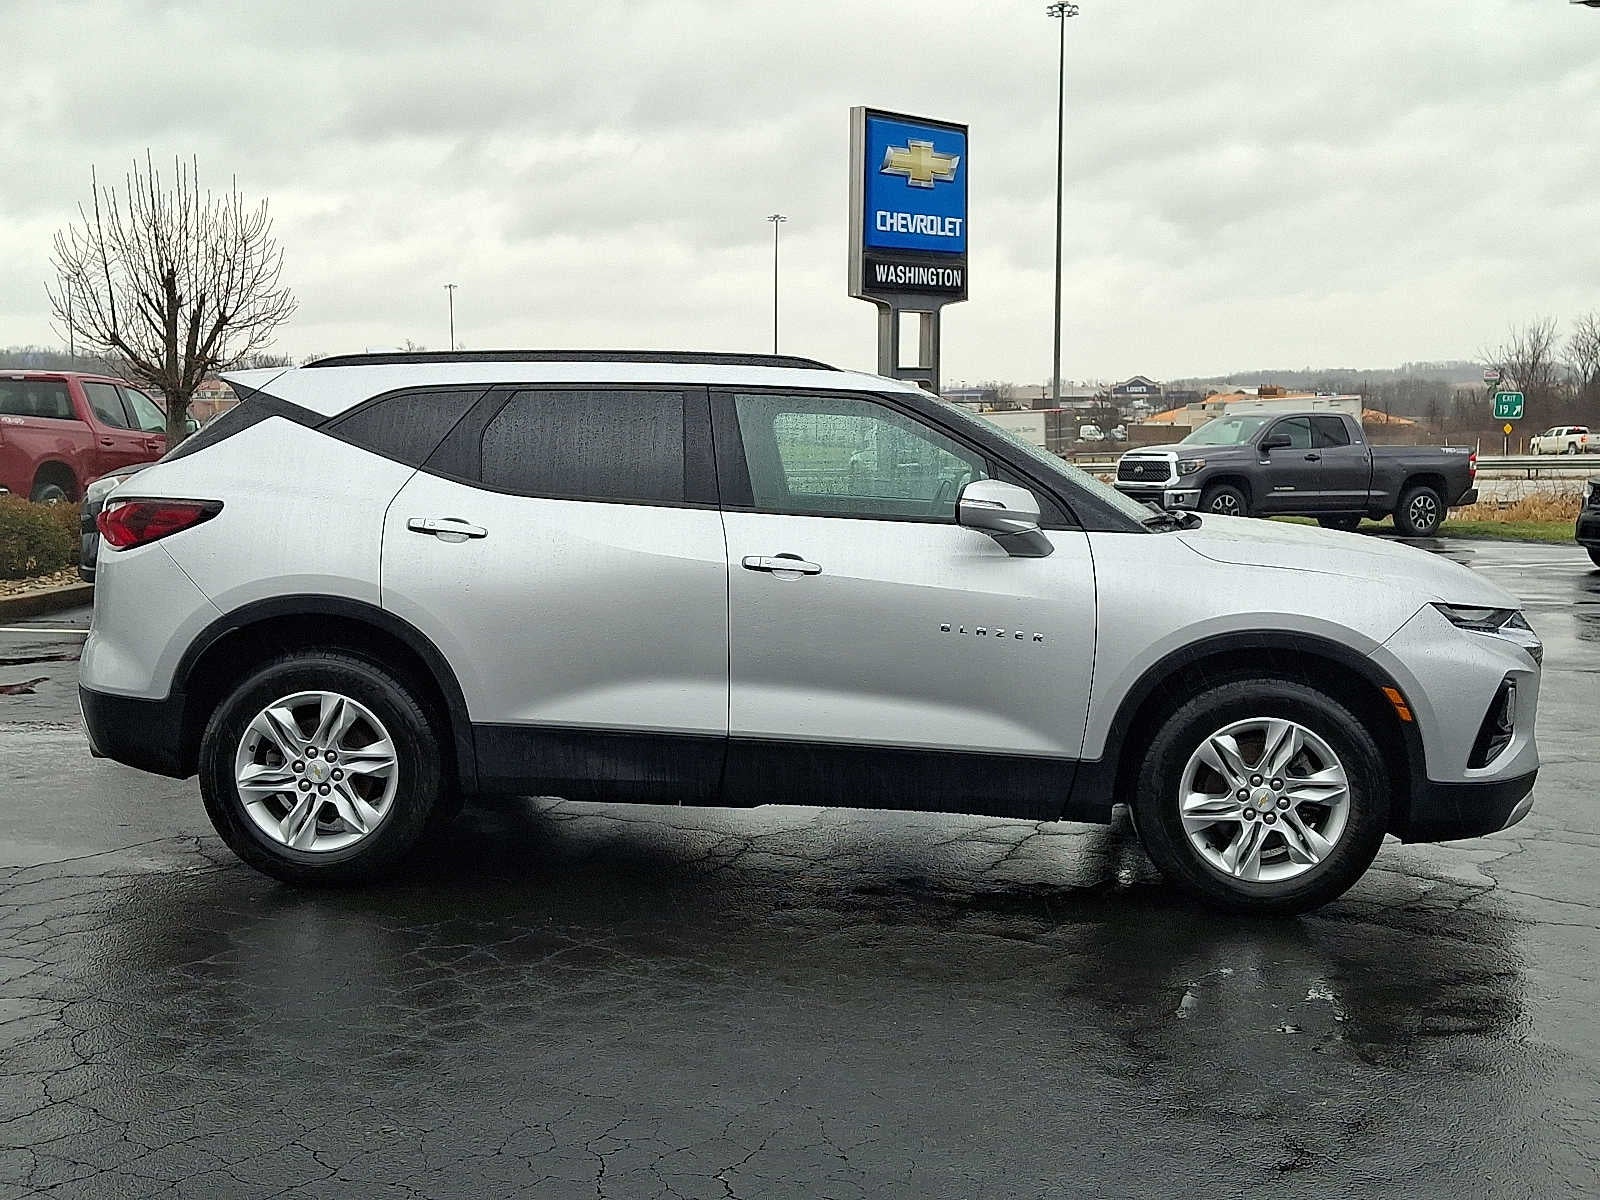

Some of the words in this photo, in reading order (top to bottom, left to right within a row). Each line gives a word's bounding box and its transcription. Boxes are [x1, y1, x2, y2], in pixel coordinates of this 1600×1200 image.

[876, 210, 963, 237] CHEVROLET
[875, 264, 962, 287] WASHINGTON
[1499, 404, 1509, 415] 19
[940, 623, 1044, 643] BLAZER
